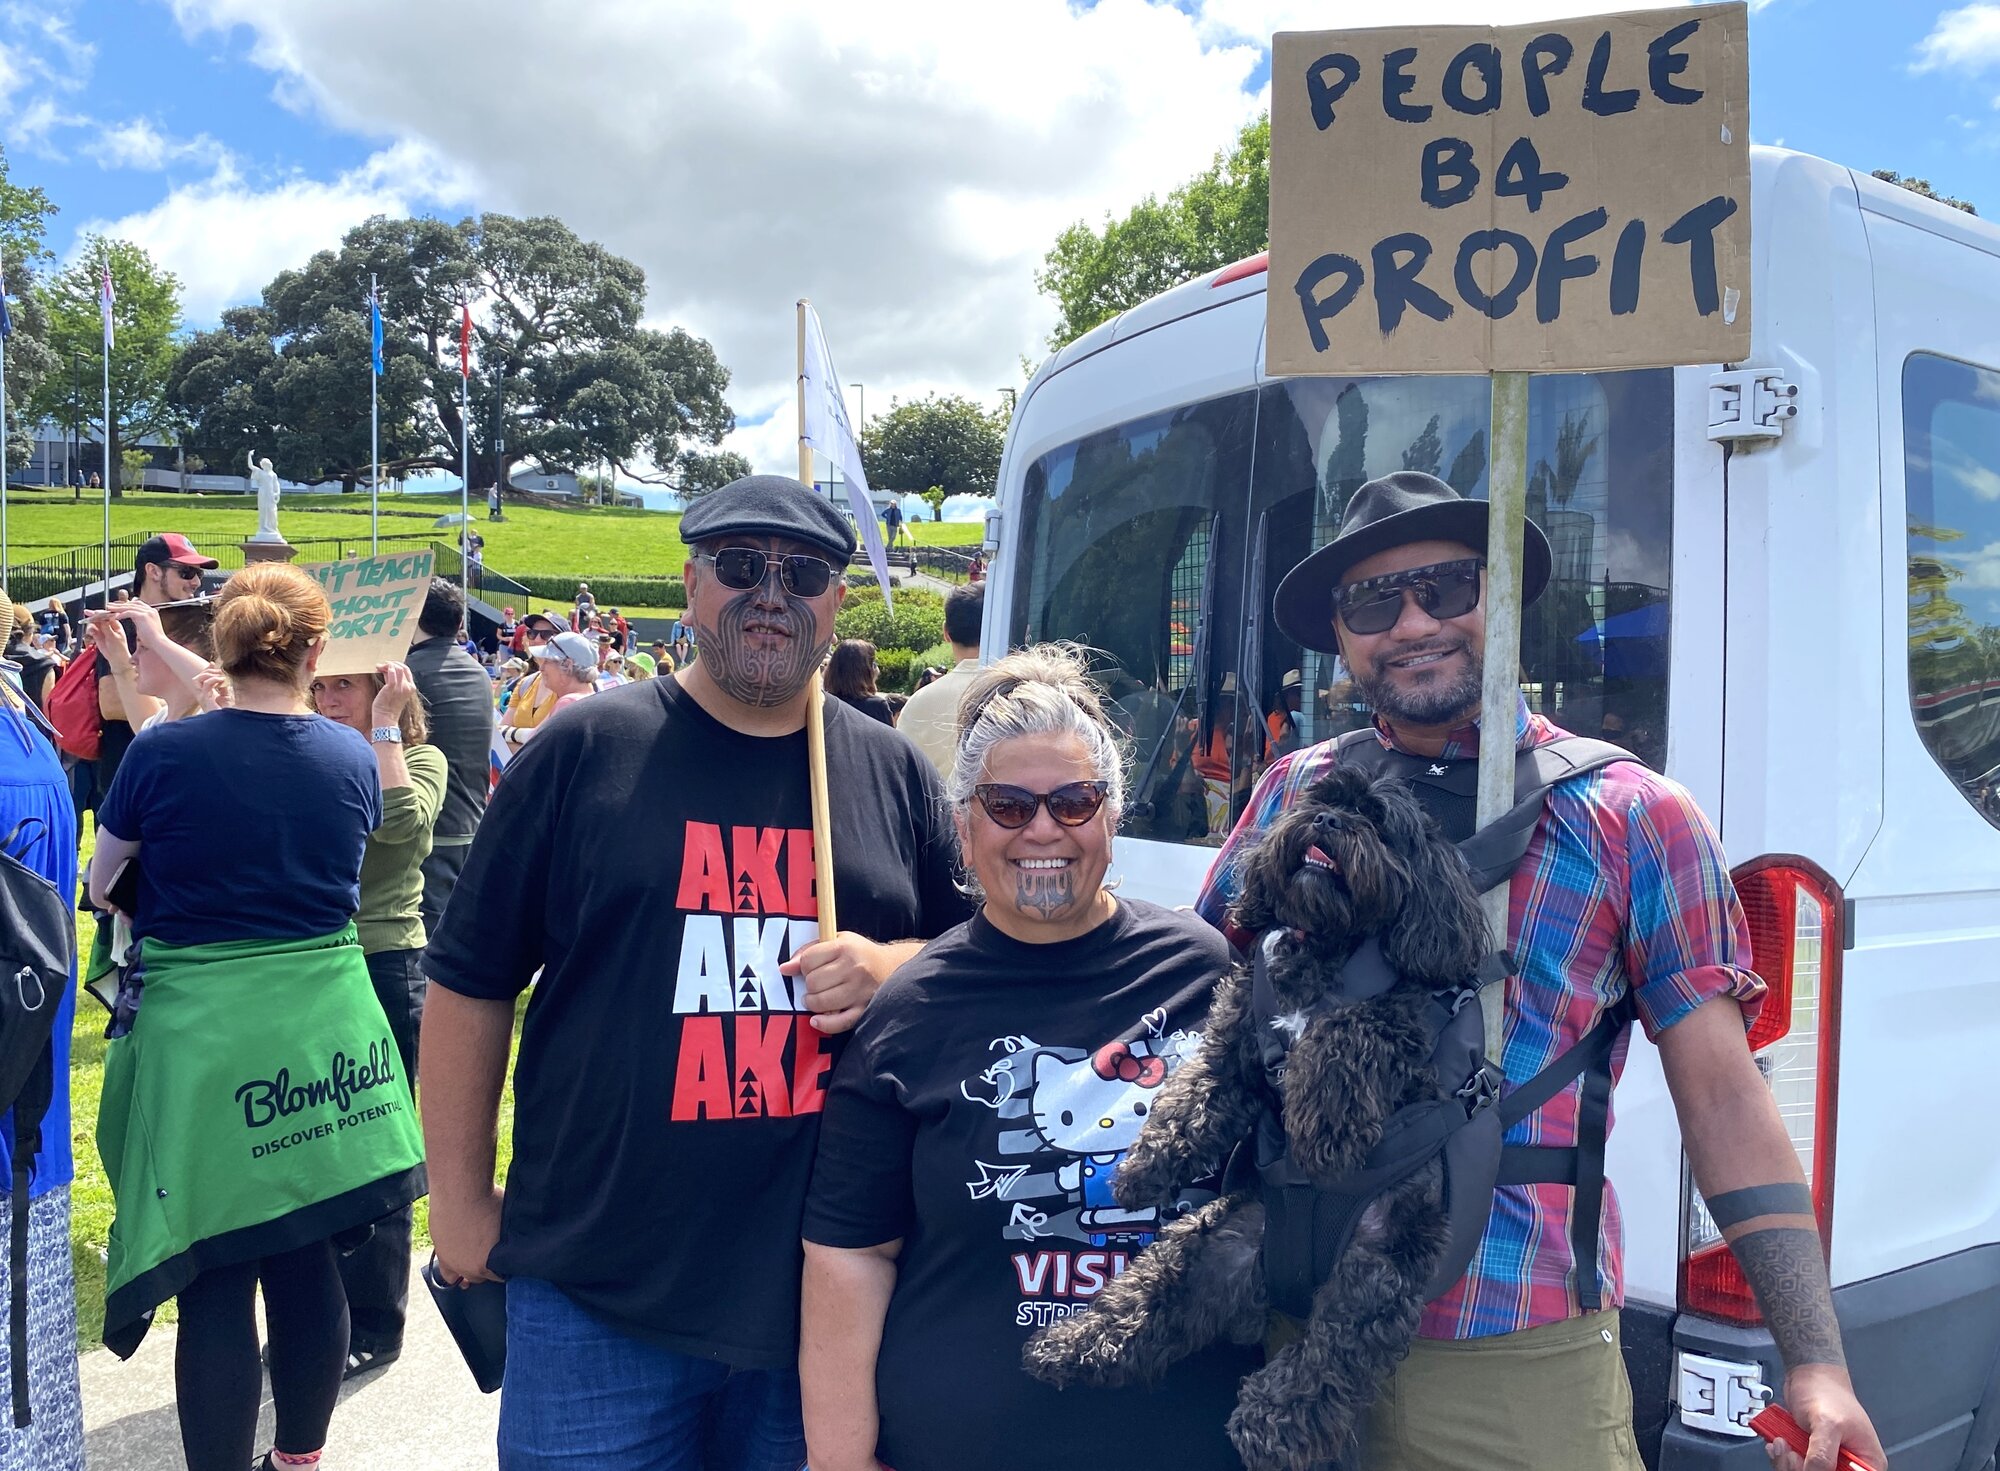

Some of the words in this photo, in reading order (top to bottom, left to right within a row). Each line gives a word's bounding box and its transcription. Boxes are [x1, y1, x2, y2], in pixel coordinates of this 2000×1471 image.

[1306, 19, 1704, 130] PEOPLE
[1420, 136, 1570, 213] B4
[1295, 196, 1737, 353] PROFIT
[308, 560, 355, 593] N'T
[356, 553, 432, 587] TEACH
[331, 587, 417, 618] THOUT
[327, 608, 409, 639] ORT!
[235, 1037, 395, 1128] Blomfield
[671, 1014, 832, 1121] AKE
[252, 1123, 334, 1158] DISCOVER
[338, 1101, 402, 1130] POTENTIAL
